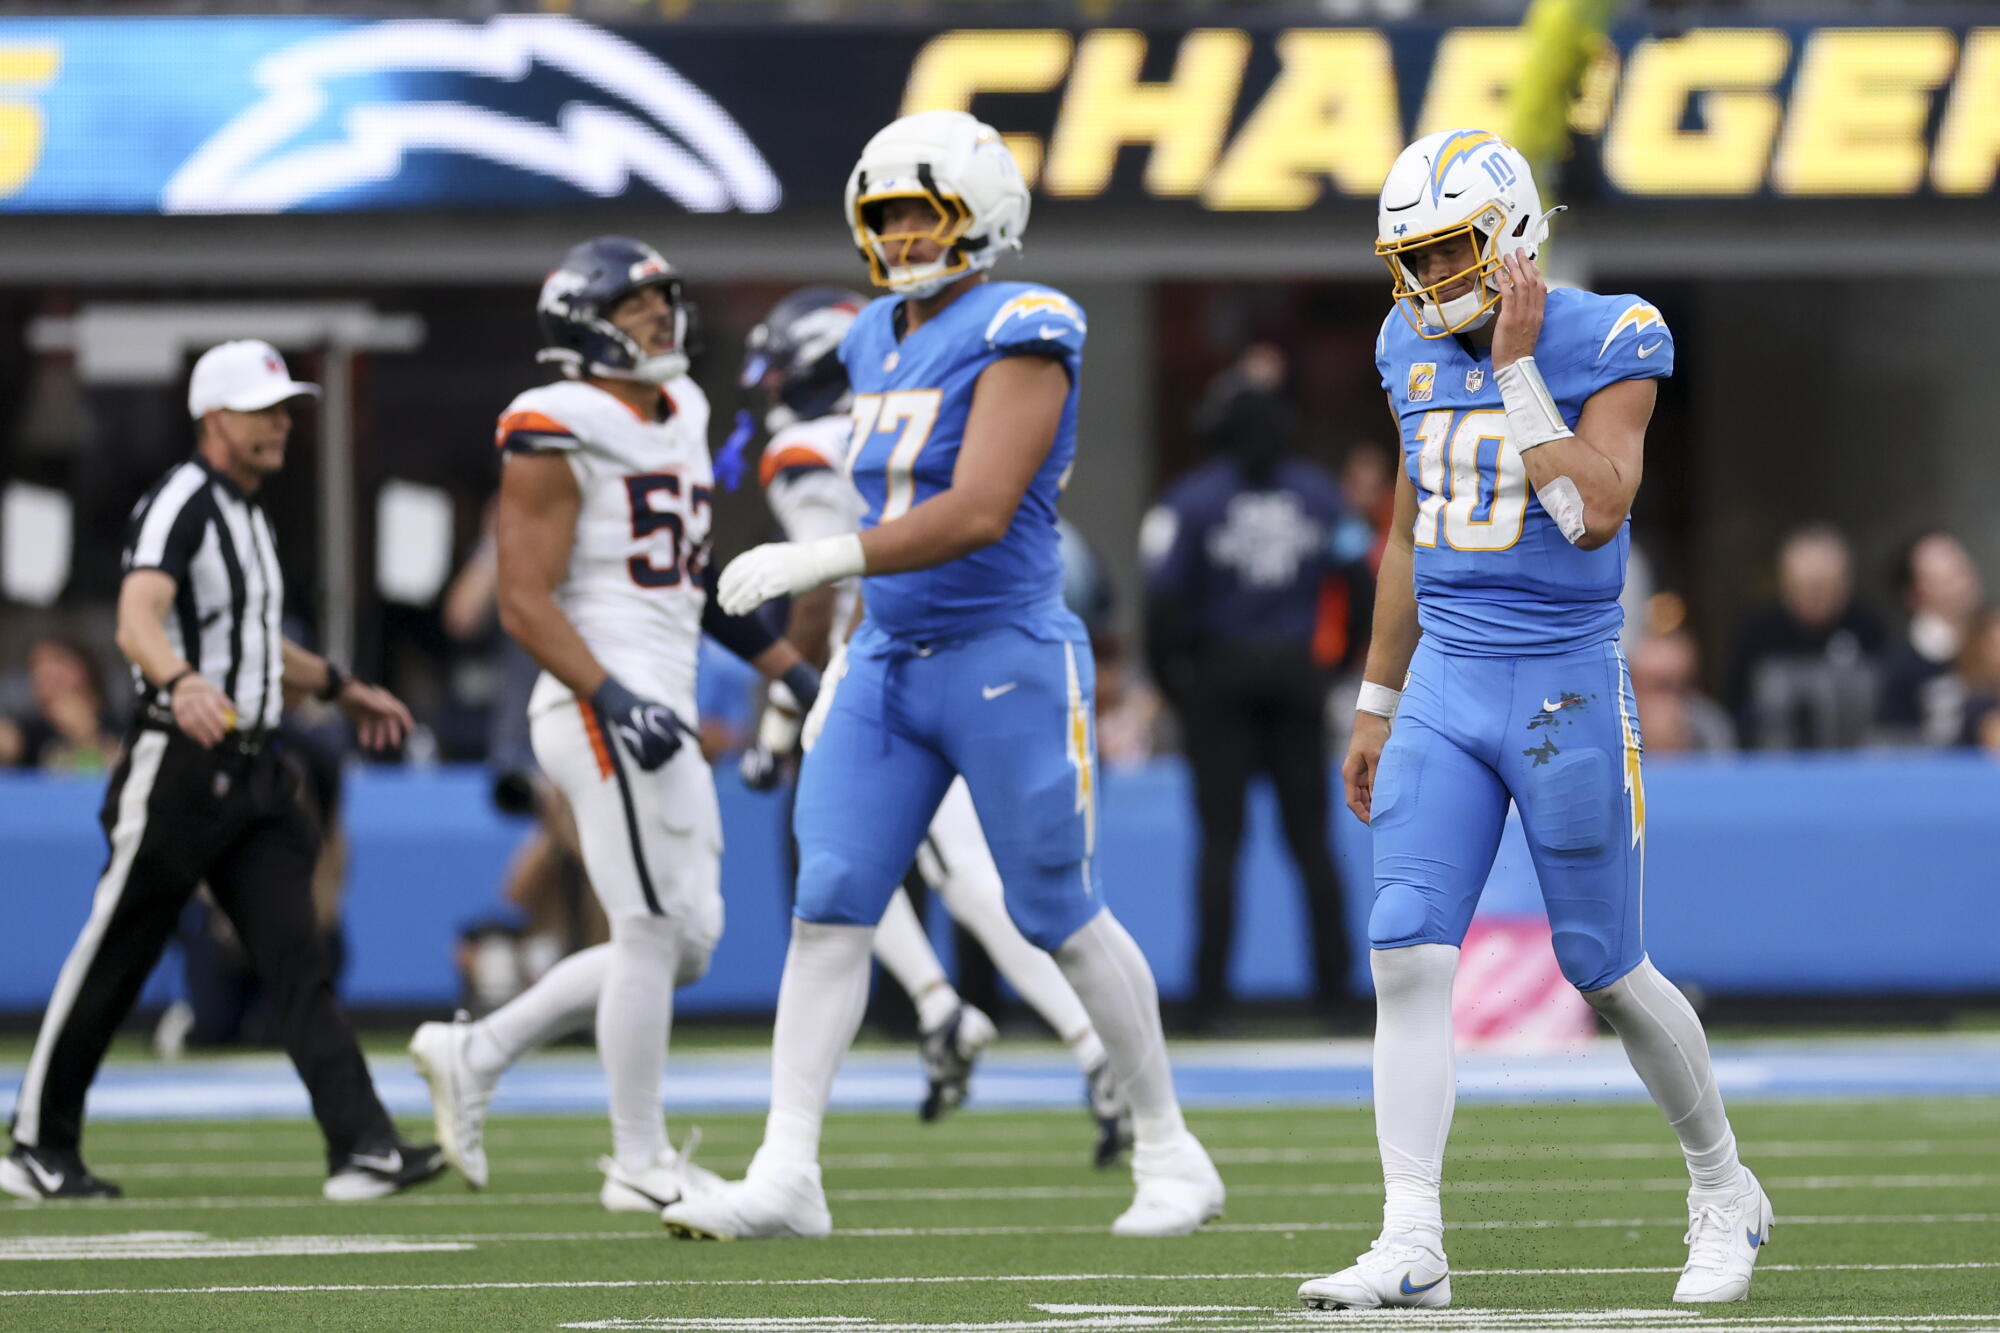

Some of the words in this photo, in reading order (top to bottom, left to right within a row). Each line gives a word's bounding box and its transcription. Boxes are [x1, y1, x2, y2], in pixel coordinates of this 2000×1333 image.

[1481, 151, 1517, 193] 10
[845, 388, 944, 524] 77
[1405, 408, 1530, 552] 10
